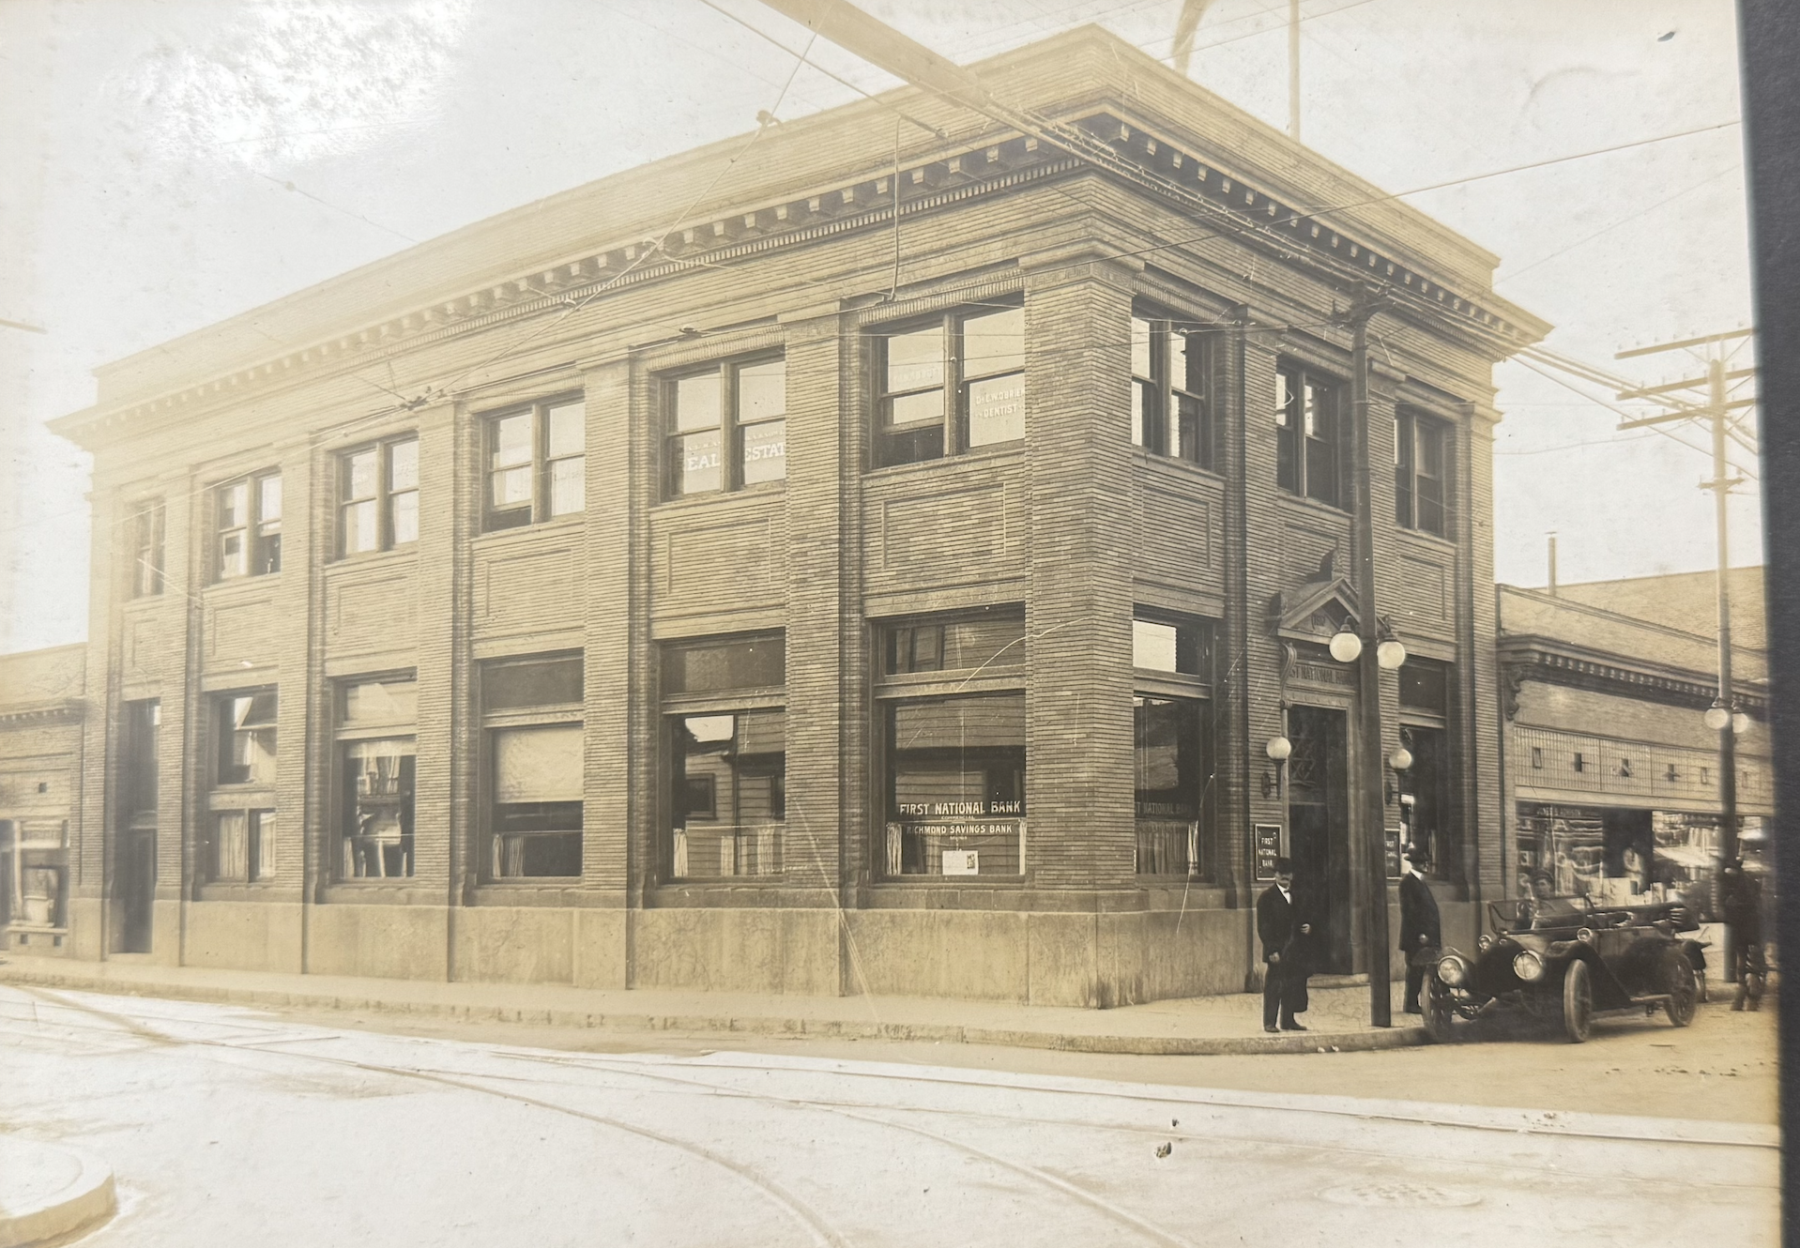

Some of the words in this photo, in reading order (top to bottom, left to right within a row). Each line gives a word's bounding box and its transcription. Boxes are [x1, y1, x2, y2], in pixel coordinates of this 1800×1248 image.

[984, 404, 1017, 418] DENTIST
[686, 453, 720, 472] EAL
[745, 441, 786, 462] ESTAT
[900, 803, 930, 815] FIRST
[935, 801, 985, 815] NATIONAL
[991, 800, 1021, 813] BANK
[1143, 802, 1175, 814] NATIONAL
[906, 825, 947, 835] RCHMOND
[950, 825, 986, 834] SAVINGS
[989, 824, 1012, 833] BANK
[1261, 837, 1274, 845] FIRST
[1258, 848, 1277, 856] NATIONAL
